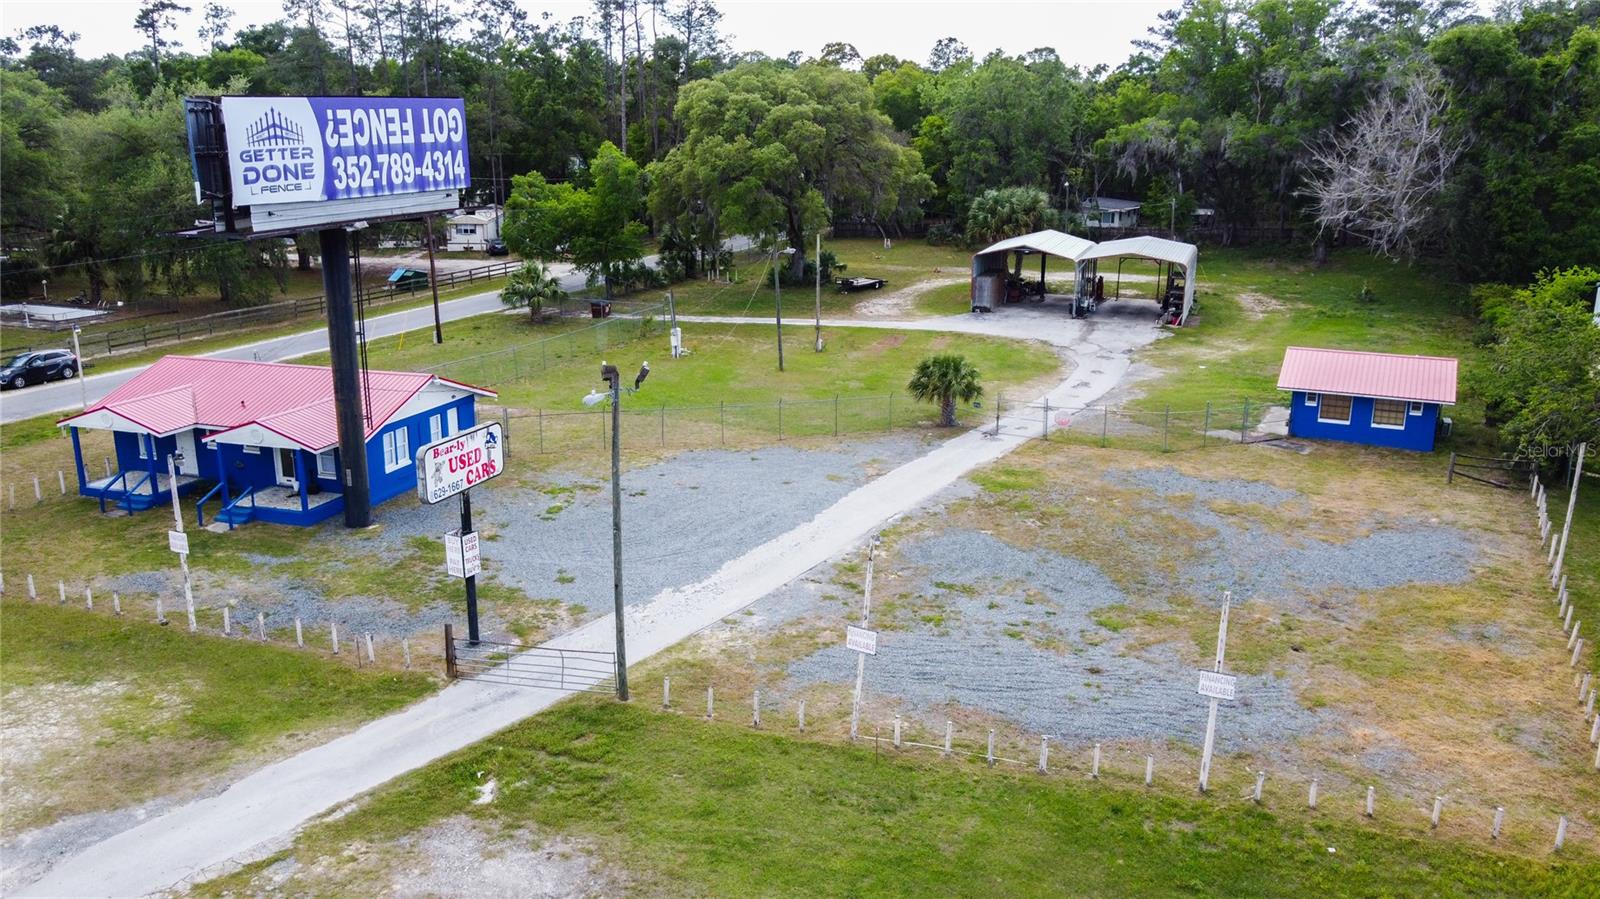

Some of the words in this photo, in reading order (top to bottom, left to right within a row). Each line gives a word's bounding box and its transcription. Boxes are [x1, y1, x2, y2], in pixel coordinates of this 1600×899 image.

[325, 107, 415, 148] FENCE?
[420, 107, 464, 144] GOT
[240, 147, 314, 163] GETTER
[242, 162, 316, 186] DONE
[331, 149, 466, 190] 352-789-4314
[260, 183, 303, 195] FENCE
[432, 440, 465, 460] Bear-ly
[448, 447, 482, 474] USED
[466, 459, 497, 486] CARS
[433, 478, 464, 500] 629-1667
[464, 535, 477, 546] USED
[465, 543, 478, 553] CARS
[1200, 683, 1234, 697] AVAILABLE
[1201, 673, 1235, 687] FINANCING
